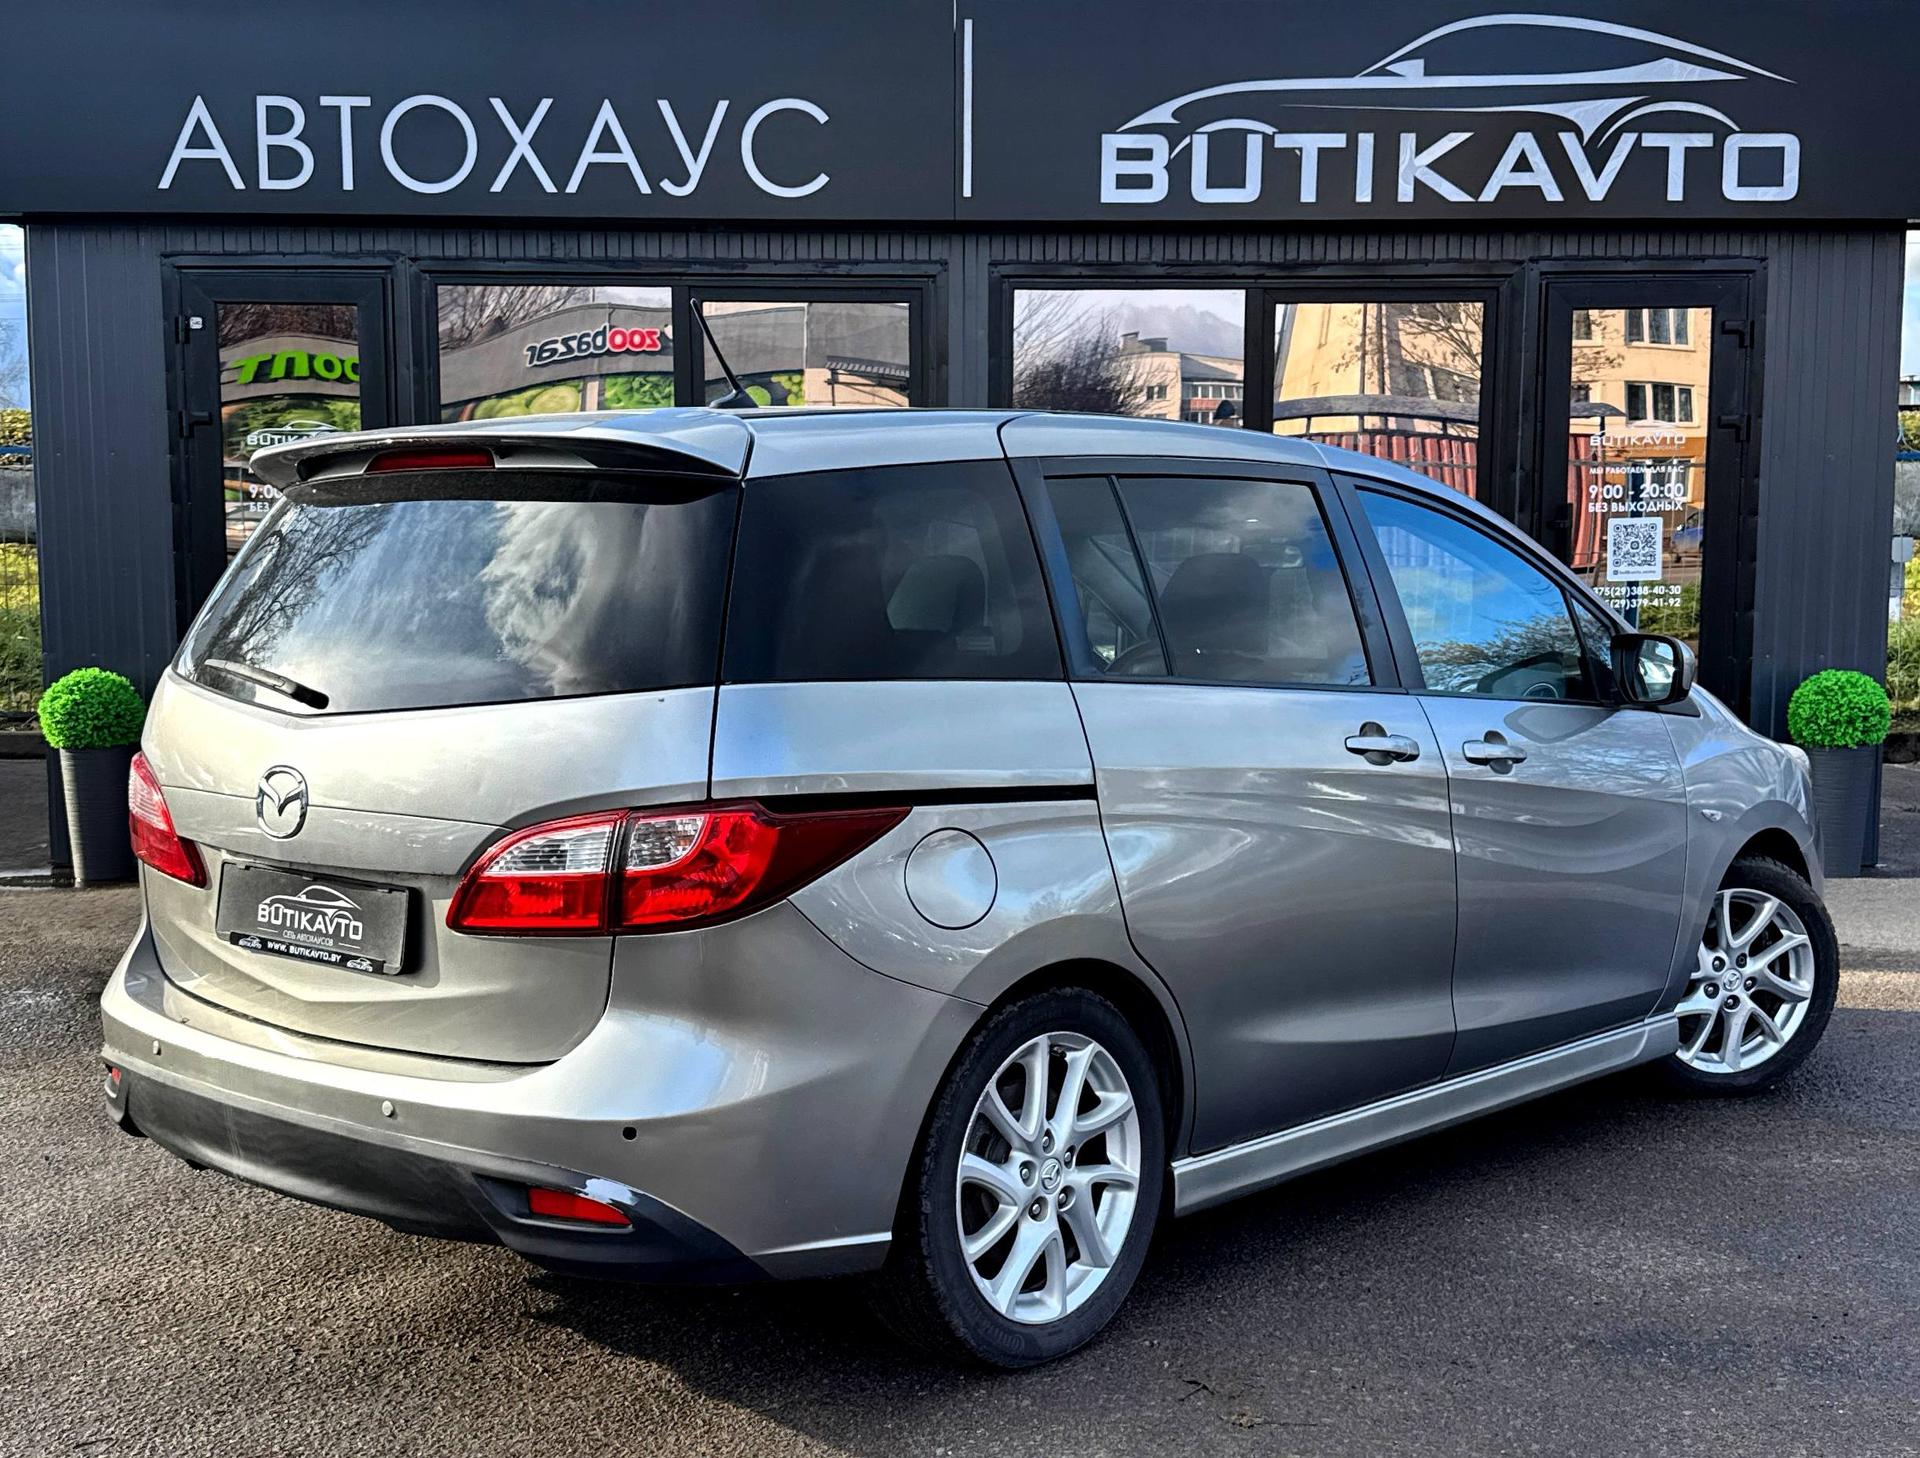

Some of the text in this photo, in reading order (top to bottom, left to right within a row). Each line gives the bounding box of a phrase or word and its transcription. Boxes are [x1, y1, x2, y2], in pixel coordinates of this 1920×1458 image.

[158, 95, 830, 198] АВТОХАУС
[1100, 131, 1801, 204] BUTIKAVTO
[1589, 434, 1686, 446] BUTIKAVTO
[1589, 485, 1623, 499] 9:00
[1640, 484, 1684, 498] 20:00
[249, 502, 270, 512] БЕЗ
[1588, 501, 1683, 513] БЕЗ ВЫХОДНЫХ
[257, 903, 363, 940] BUTIKAVTO
